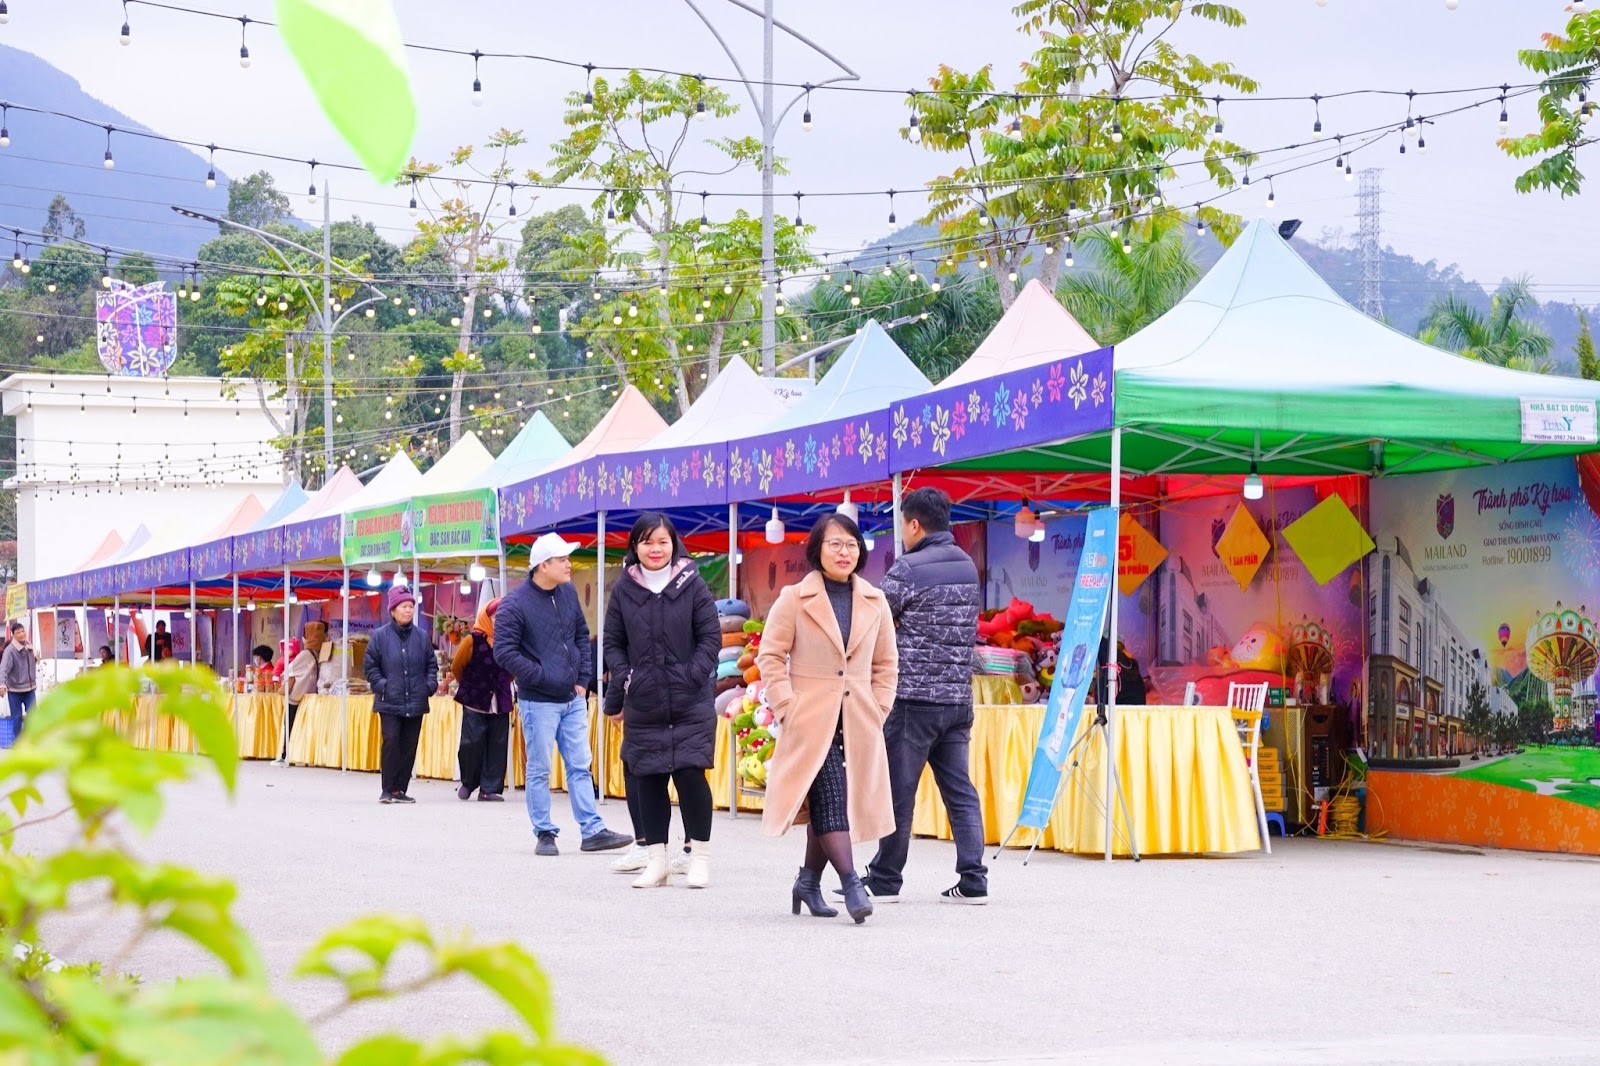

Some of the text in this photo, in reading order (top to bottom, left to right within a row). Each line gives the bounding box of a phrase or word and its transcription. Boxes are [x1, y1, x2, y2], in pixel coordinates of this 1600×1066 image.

[1472, 482, 1573, 516] Thành phố Kỳ hoa
[1424, 544, 1467, 561] MAILAND
[1507, 545, 1551, 565] 19001899
